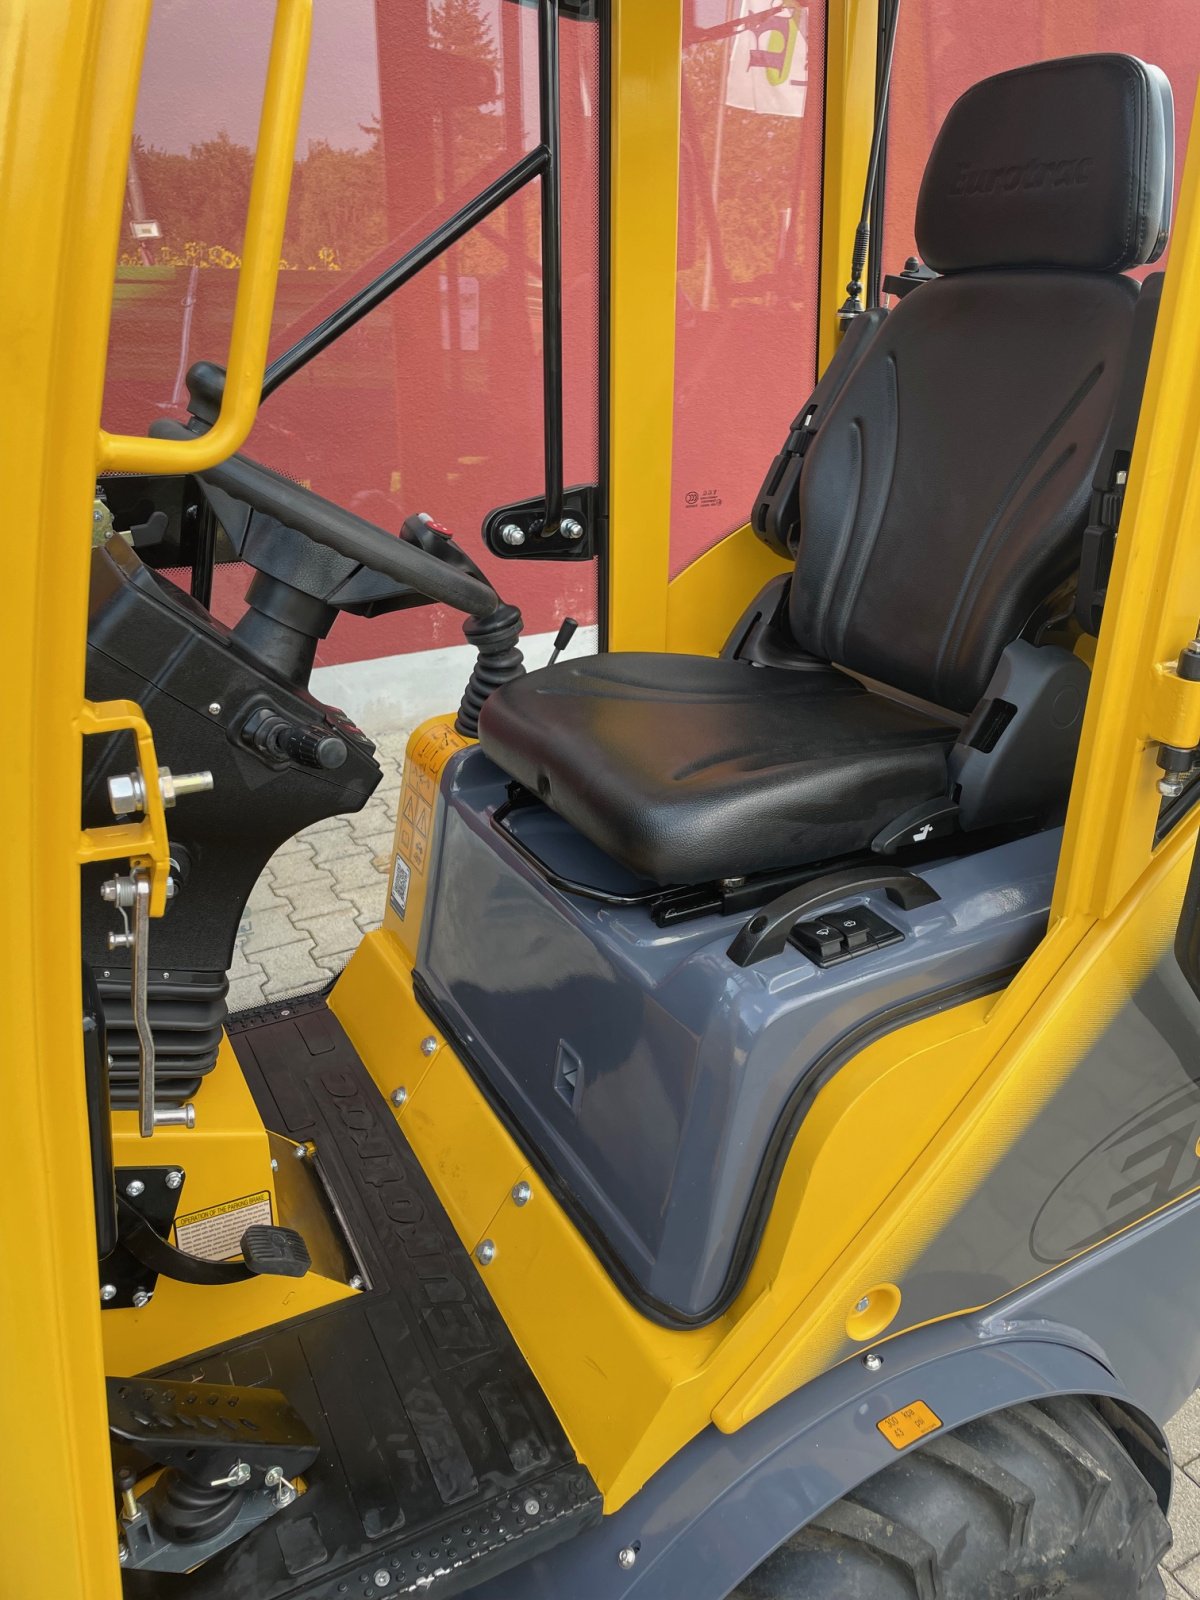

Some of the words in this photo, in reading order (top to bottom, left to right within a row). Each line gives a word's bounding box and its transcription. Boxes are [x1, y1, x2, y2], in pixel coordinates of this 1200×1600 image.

[180, 1211, 208, 1225] OPERATION
[209, 1208, 217, 1217] OF
[217, 1205, 227, 1214] THE
[227, 1199, 248, 1211] PARKING
[249, 1193, 265, 1204] BRAKE
[884, 1416, 899, 1428] 300
[894, 1427, 905, 1438] 43
